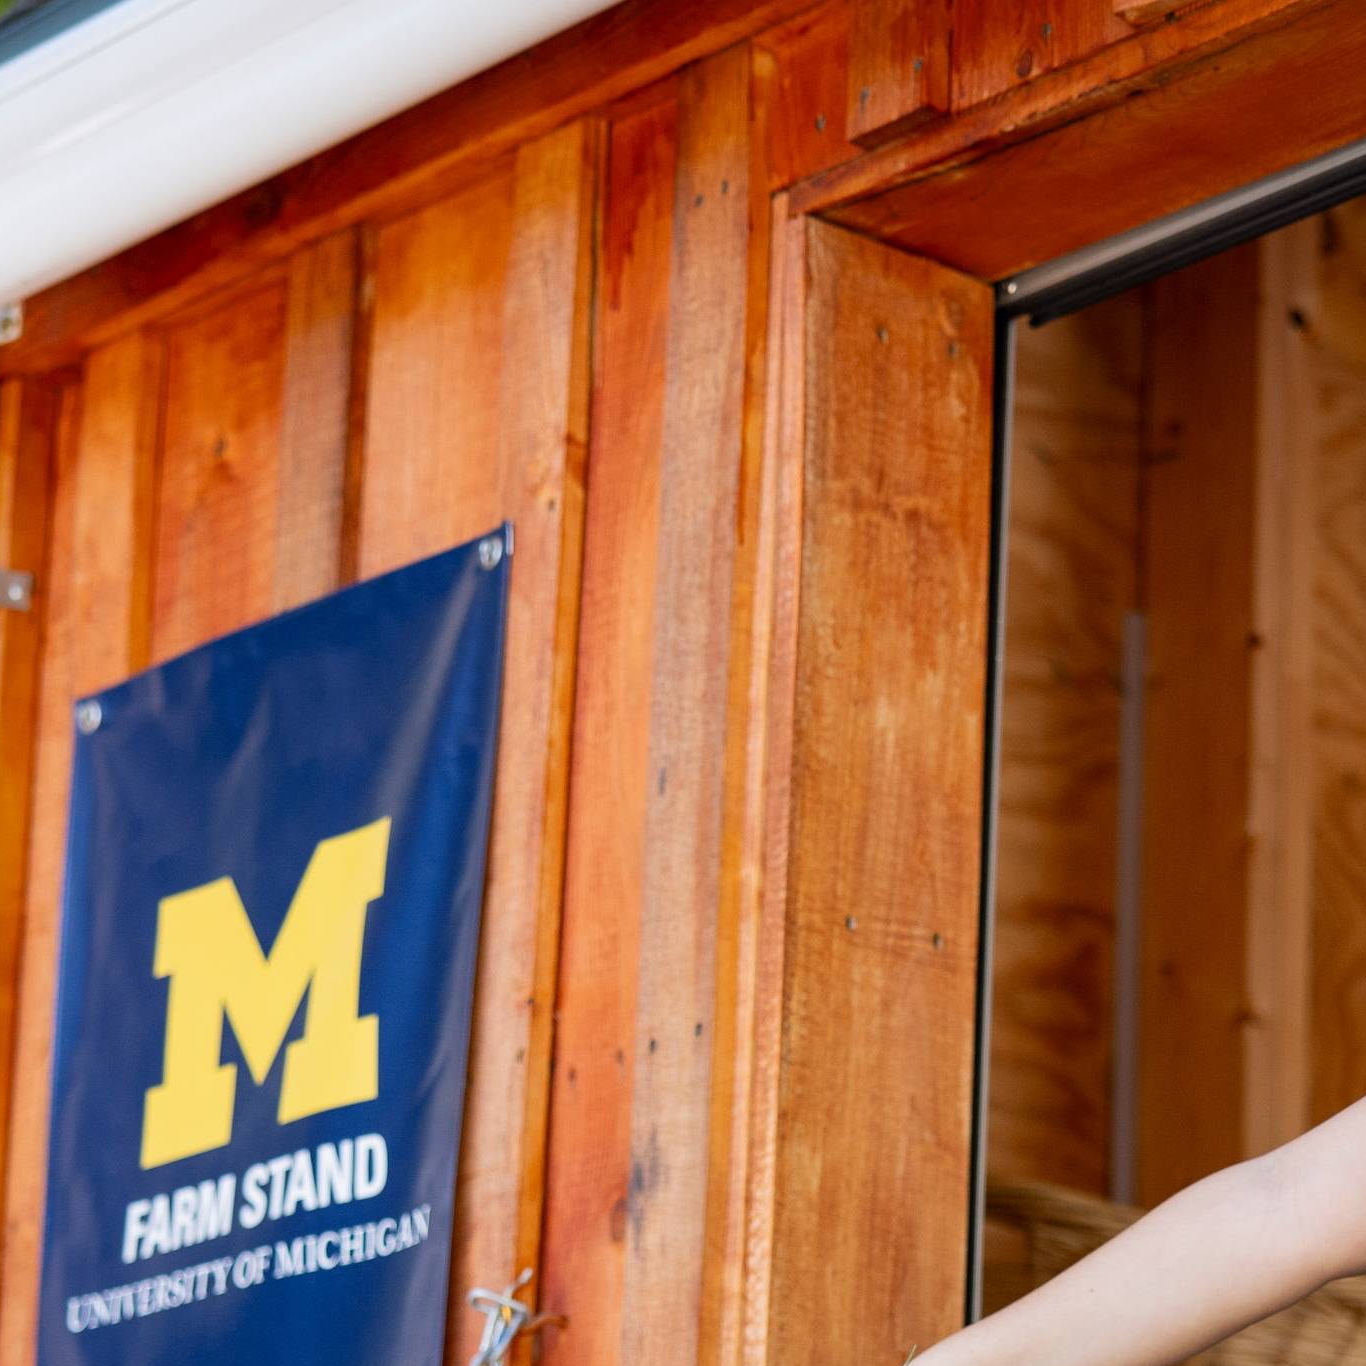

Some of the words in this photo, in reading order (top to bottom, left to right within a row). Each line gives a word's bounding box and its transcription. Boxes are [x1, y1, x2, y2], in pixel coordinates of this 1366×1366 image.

[138, 816, 392, 1170] M
[121, 1172, 237, 1265] FARM
[238, 1132, 388, 1229] STAND
[66, 1255, 233, 1334] UNIVERSITY
[232, 1245, 273, 1290] OF
[271, 1203, 432, 1280] MICHIGAN
